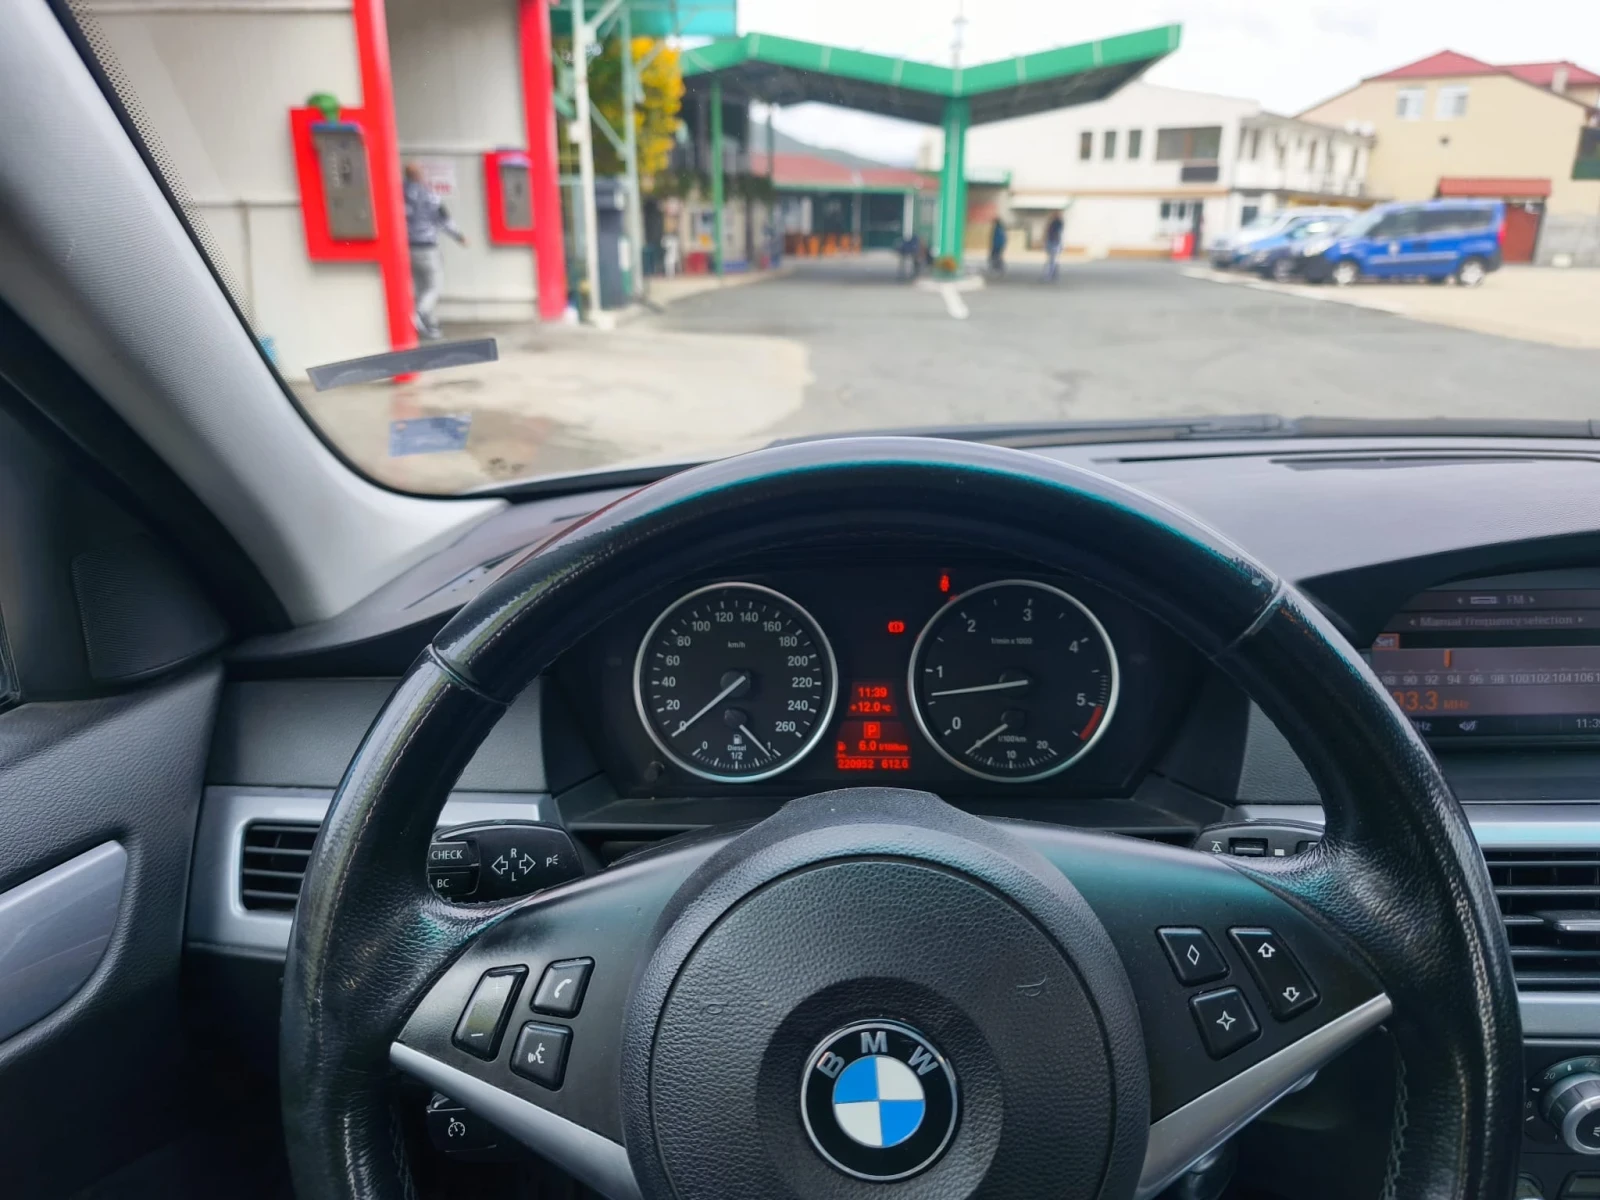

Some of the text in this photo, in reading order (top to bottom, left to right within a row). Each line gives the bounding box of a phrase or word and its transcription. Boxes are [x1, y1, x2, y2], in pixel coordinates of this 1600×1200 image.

[715, 612, 734, 622] 120
[740, 612, 759, 622] 140
[1023, 608, 1032, 622] 3
[692, 621, 711, 632] 100
[763, 621, 782, 632] 160
[967, 620, 976, 632] 2
[1420, 617, 1461, 626] Manual
[677, 636, 691, 647] 80
[727, 640, 746, 649] km/h
[779, 636, 798, 647] 180
[1069, 640, 1079, 653] 4
[666, 655, 680, 666] 60
[787, 656, 809, 666] 200
[936, 665, 944, 678] 1
[661, 676, 676, 688] 40
[792, 677, 813, 688] 220
[1424, 674, 1439, 685] 92
[1446, 674, 1461, 684] 94
[1469, 674, 1484, 684] 96
[858, 687, 888, 698] 11:39
[666, 700, 680, 710] 20
[1076, 693, 1086, 706] 5
[787, 700, 809, 711] 240
[775, 721, 796, 732] 260
[952, 716, 962, 730] 0
[702, 741, 708, 750] 0
[767, 742, 772, 750] 1
[858, 740, 877, 751] 6.0
[1037, 740, 1049, 750] 20
[731, 752, 743, 760] 1/2
[1006, 750, 1016, 759] 10
[431, 850, 463, 860] CHECK
[511, 848, 518, 858] R
[511, 872, 517, 882] L
[437, 878, 450, 888] BC
[816, 1030, 939, 1080] BMW
